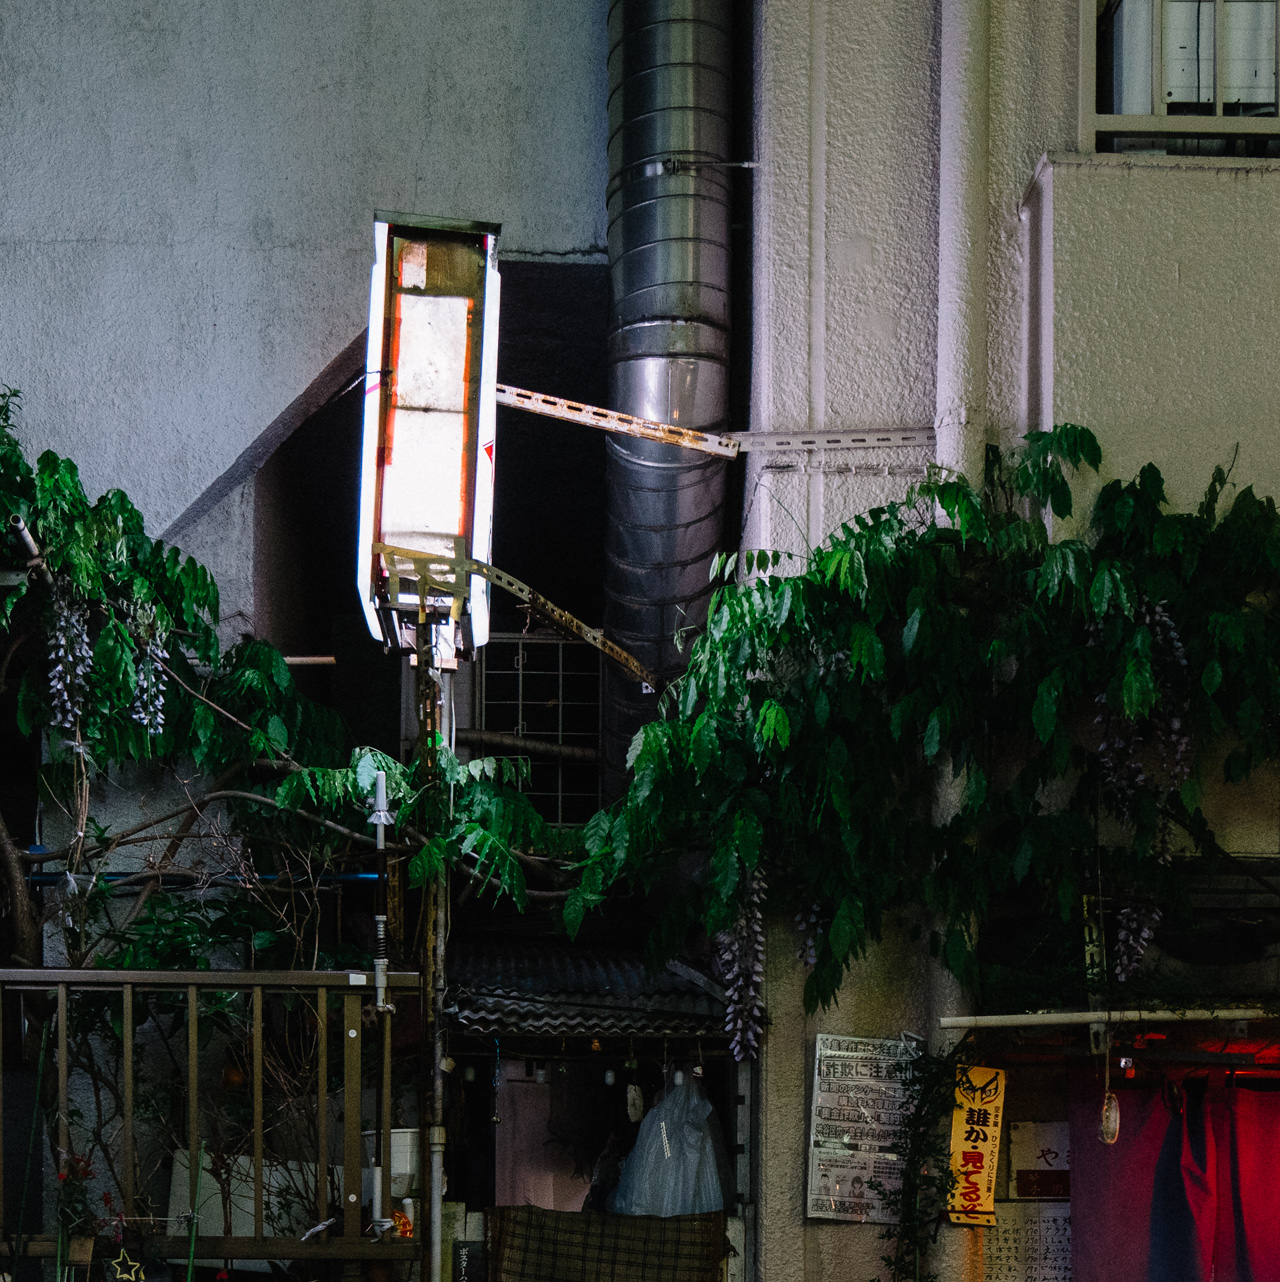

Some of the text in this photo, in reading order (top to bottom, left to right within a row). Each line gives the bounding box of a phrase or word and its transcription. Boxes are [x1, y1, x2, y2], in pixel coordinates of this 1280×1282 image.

[960, 1107, 991, 1219] 誰か・見てるぞ
